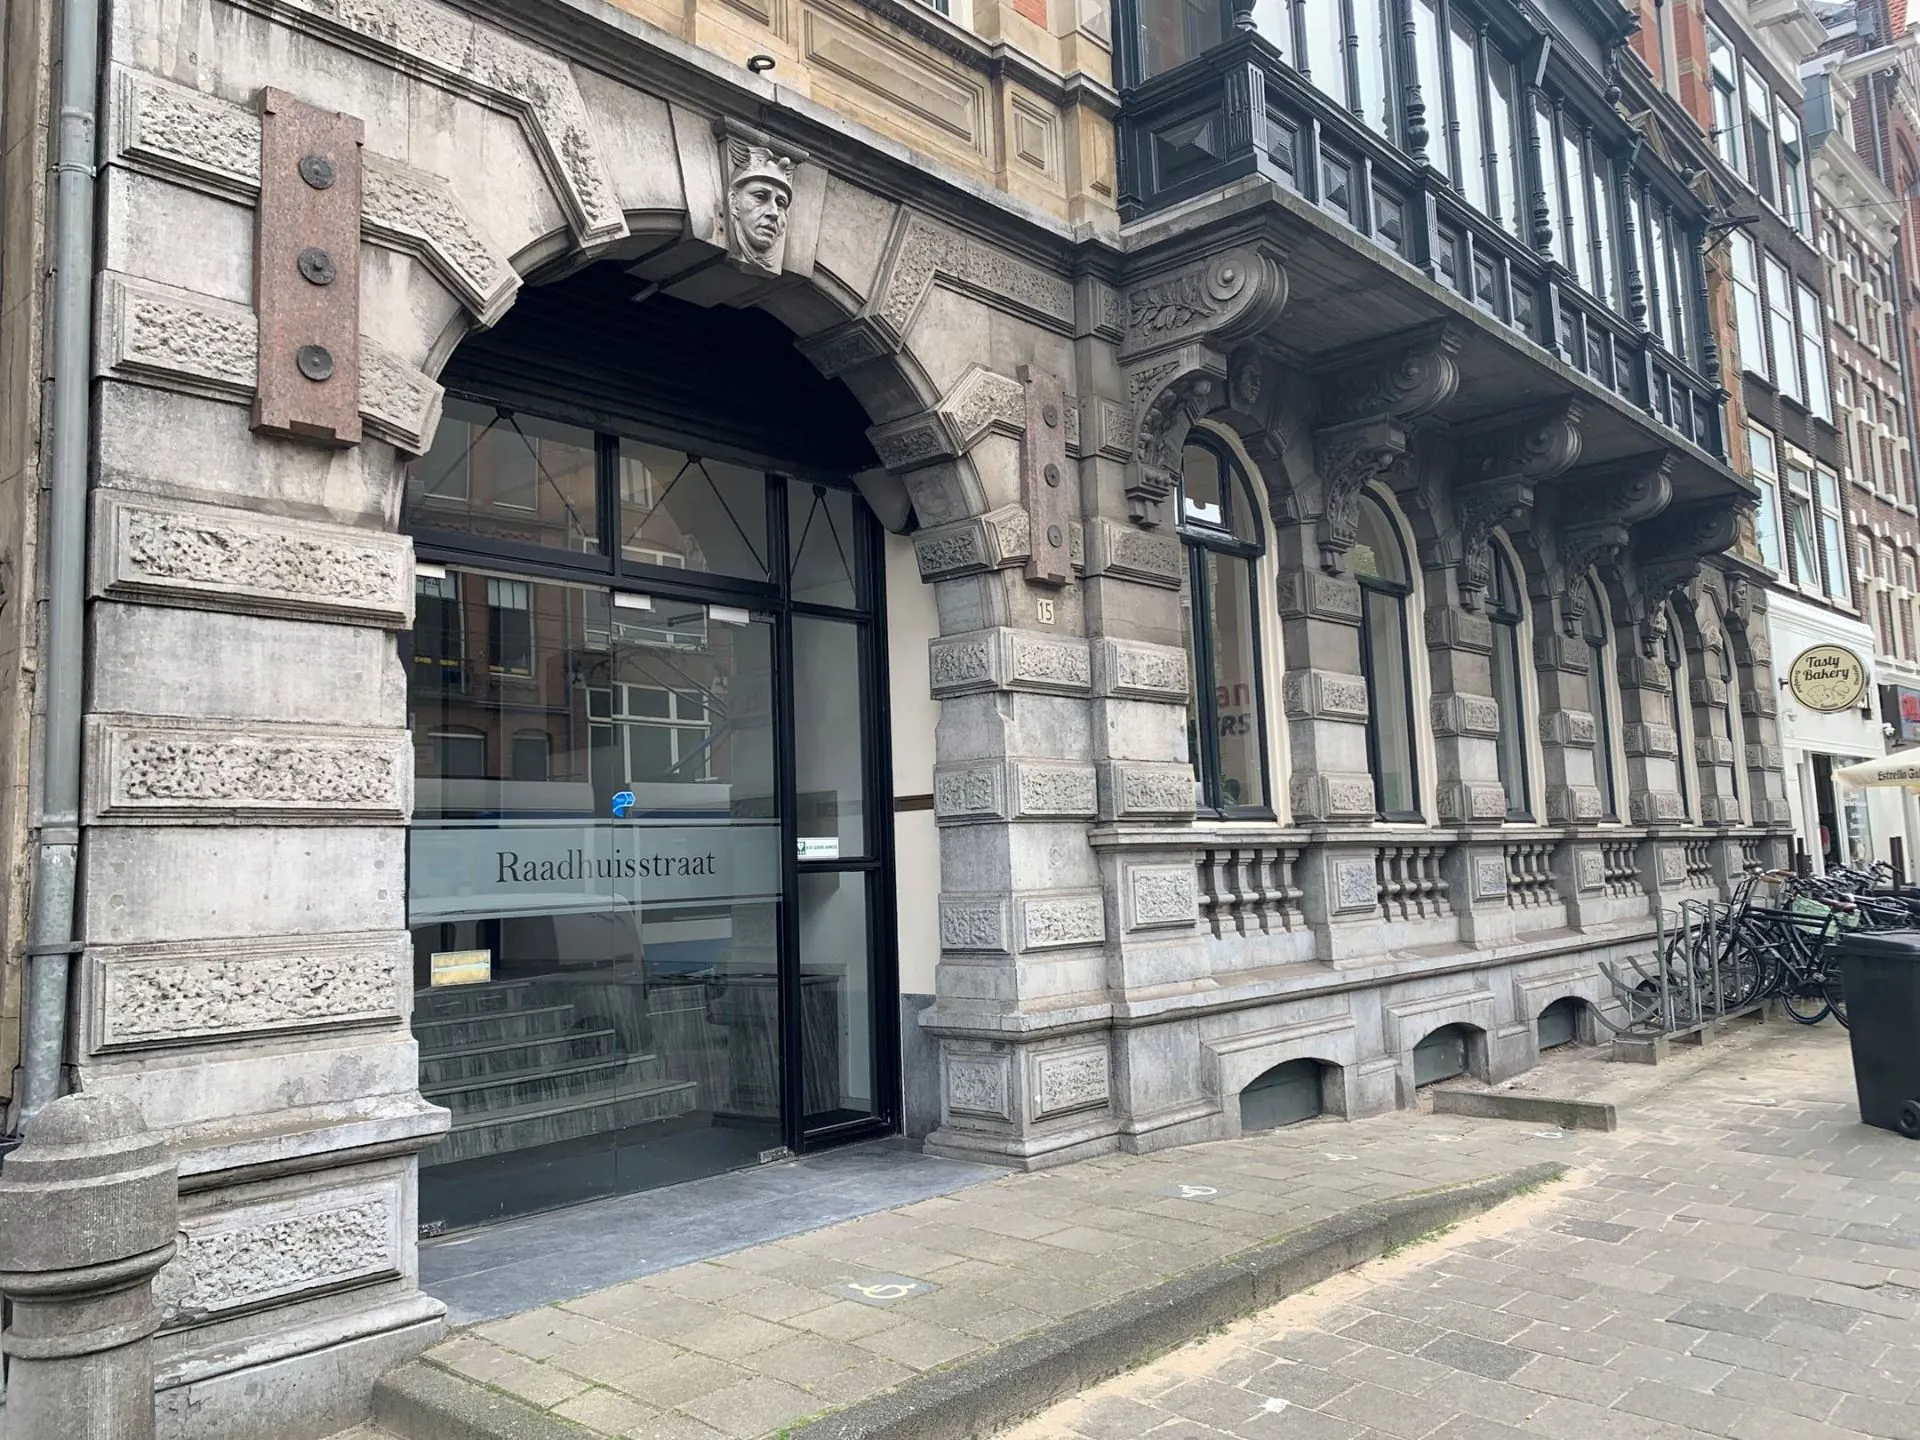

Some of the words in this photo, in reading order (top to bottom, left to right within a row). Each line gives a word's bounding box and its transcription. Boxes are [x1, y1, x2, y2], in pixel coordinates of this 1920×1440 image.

[1039, 601, 1053, 621] 15
[1805, 655, 1840, 668] Tasty
[1802, 668, 1850, 681] Bakery
[1216, 713, 1251, 736] RS
[496, 849, 716, 883] Raadhuisstraat
